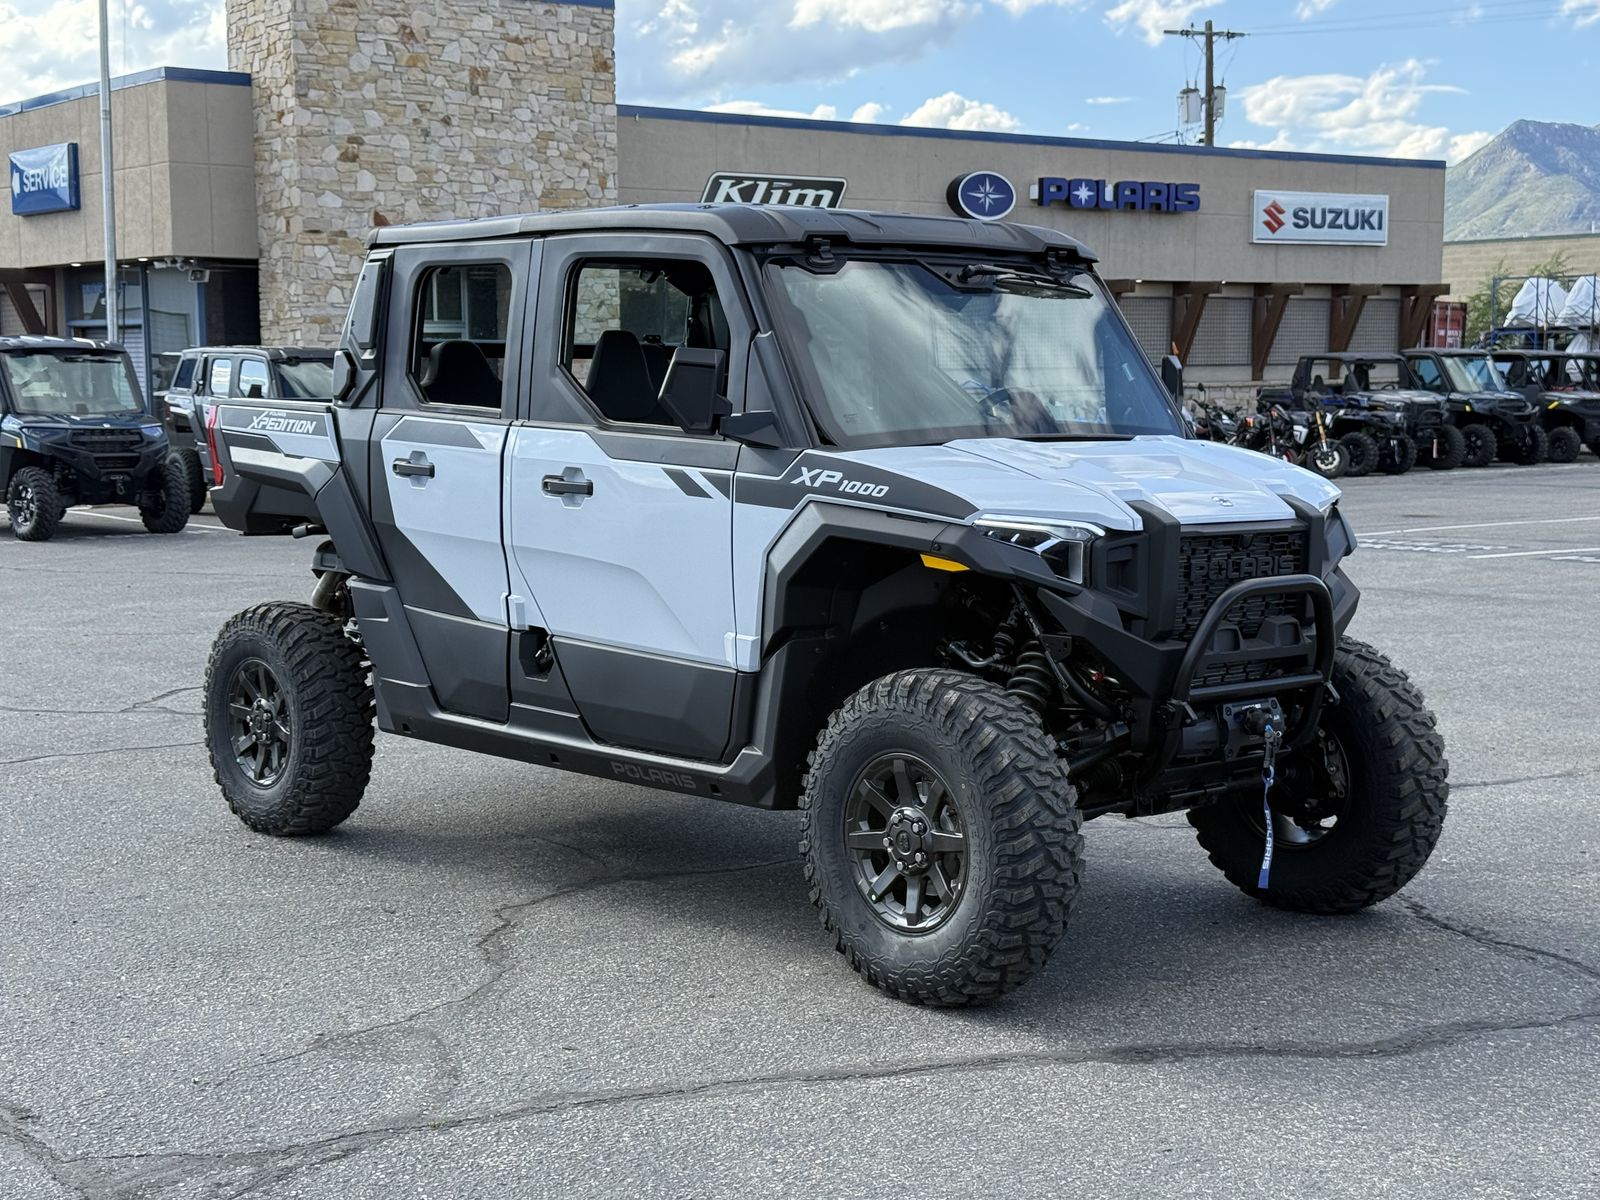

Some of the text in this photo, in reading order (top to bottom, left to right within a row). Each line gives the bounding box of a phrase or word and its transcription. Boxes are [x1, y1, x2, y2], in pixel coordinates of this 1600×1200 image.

[22, 165, 68, 193] SERVICE
[1038, 177, 1200, 212] POLARIS
[1292, 206, 1383, 231] SUZUKI
[249, 411, 317, 434] XPEDITION
[790, 466, 890, 498] XP 1000
[1190, 554, 1294, 582] POLARIS
[609, 761, 697, 789] POLARIS
[1261, 808, 1275, 870] POLARIS
